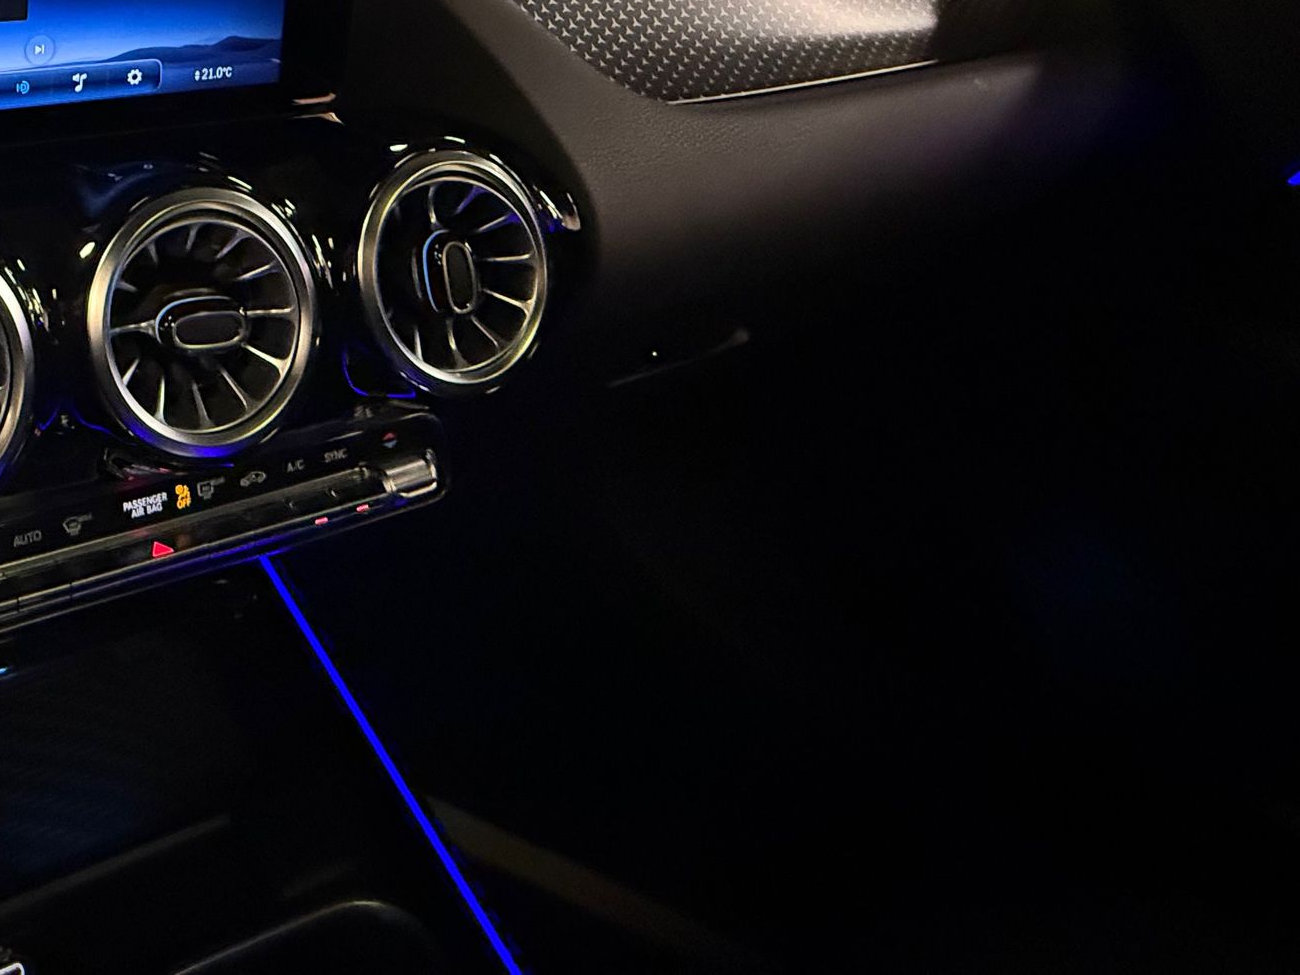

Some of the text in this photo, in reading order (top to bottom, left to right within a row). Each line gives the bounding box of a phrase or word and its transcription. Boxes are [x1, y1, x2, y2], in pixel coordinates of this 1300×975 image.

[201, 66, 232, 80] 21.0°C
[323, 448, 348, 463] SYNC
[286, 459, 305, 473] A/C
[122, 491, 167, 513] PASSENGER
[176, 497, 191, 509] OFF
[131, 501, 163, 519] AIR BAG
[13, 529, 43, 547] AUTO
